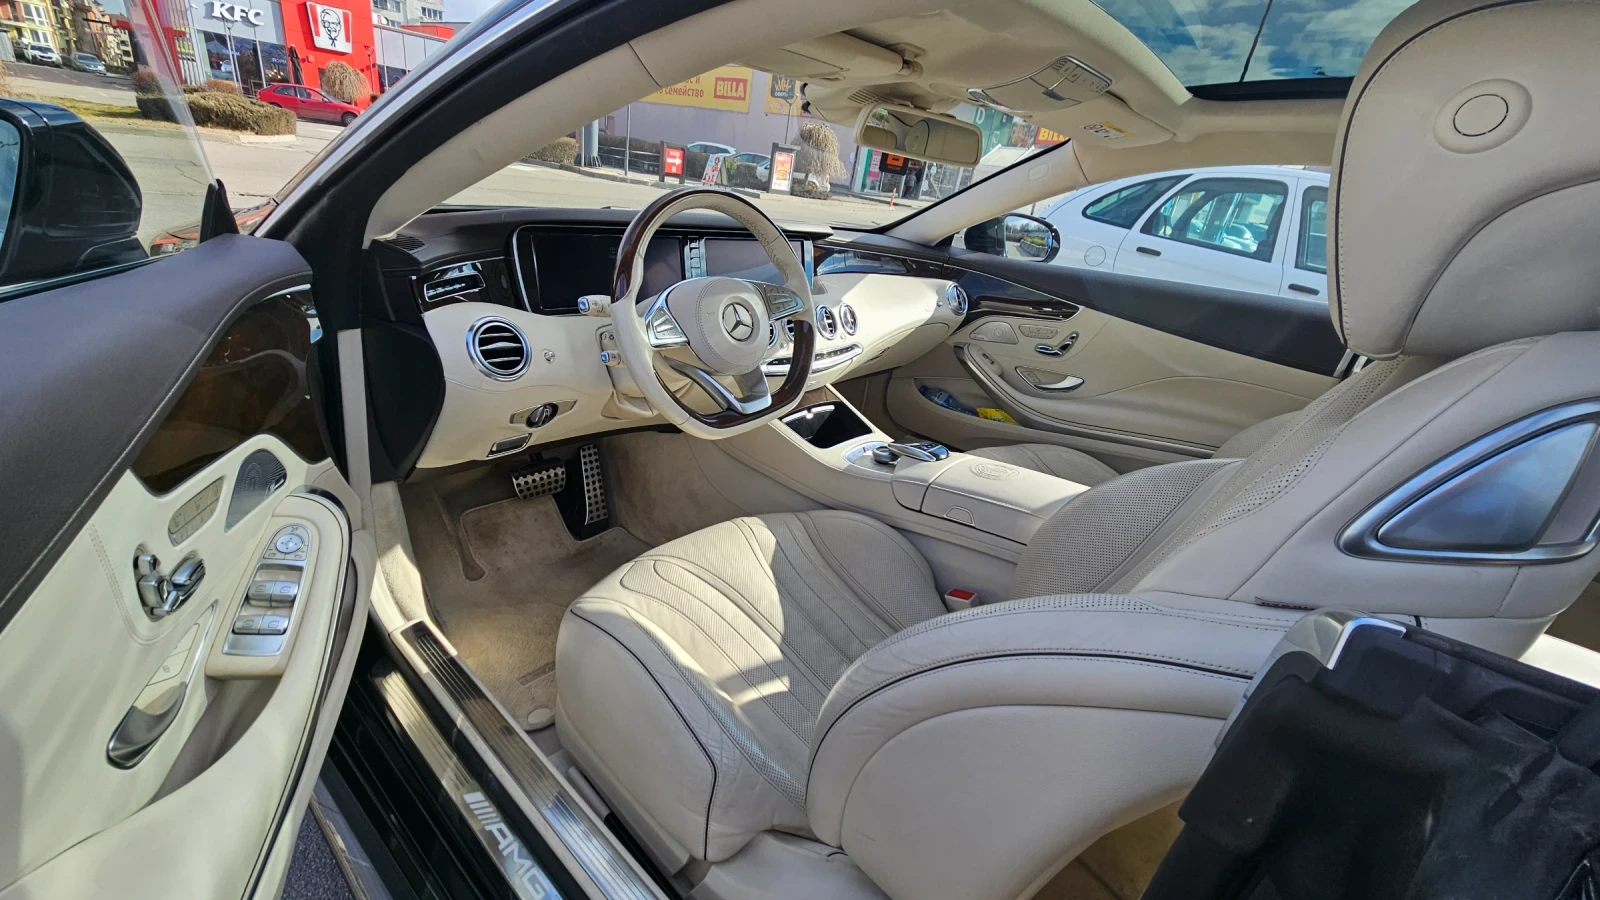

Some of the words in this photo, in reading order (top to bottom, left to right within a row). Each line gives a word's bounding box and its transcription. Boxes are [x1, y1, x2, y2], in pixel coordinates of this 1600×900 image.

[212, 1, 264, 26] KFC
[715, 80, 745, 98] BILLA
[1038, 127, 1069, 142] BILL
[484, 822, 550, 900] AMG
